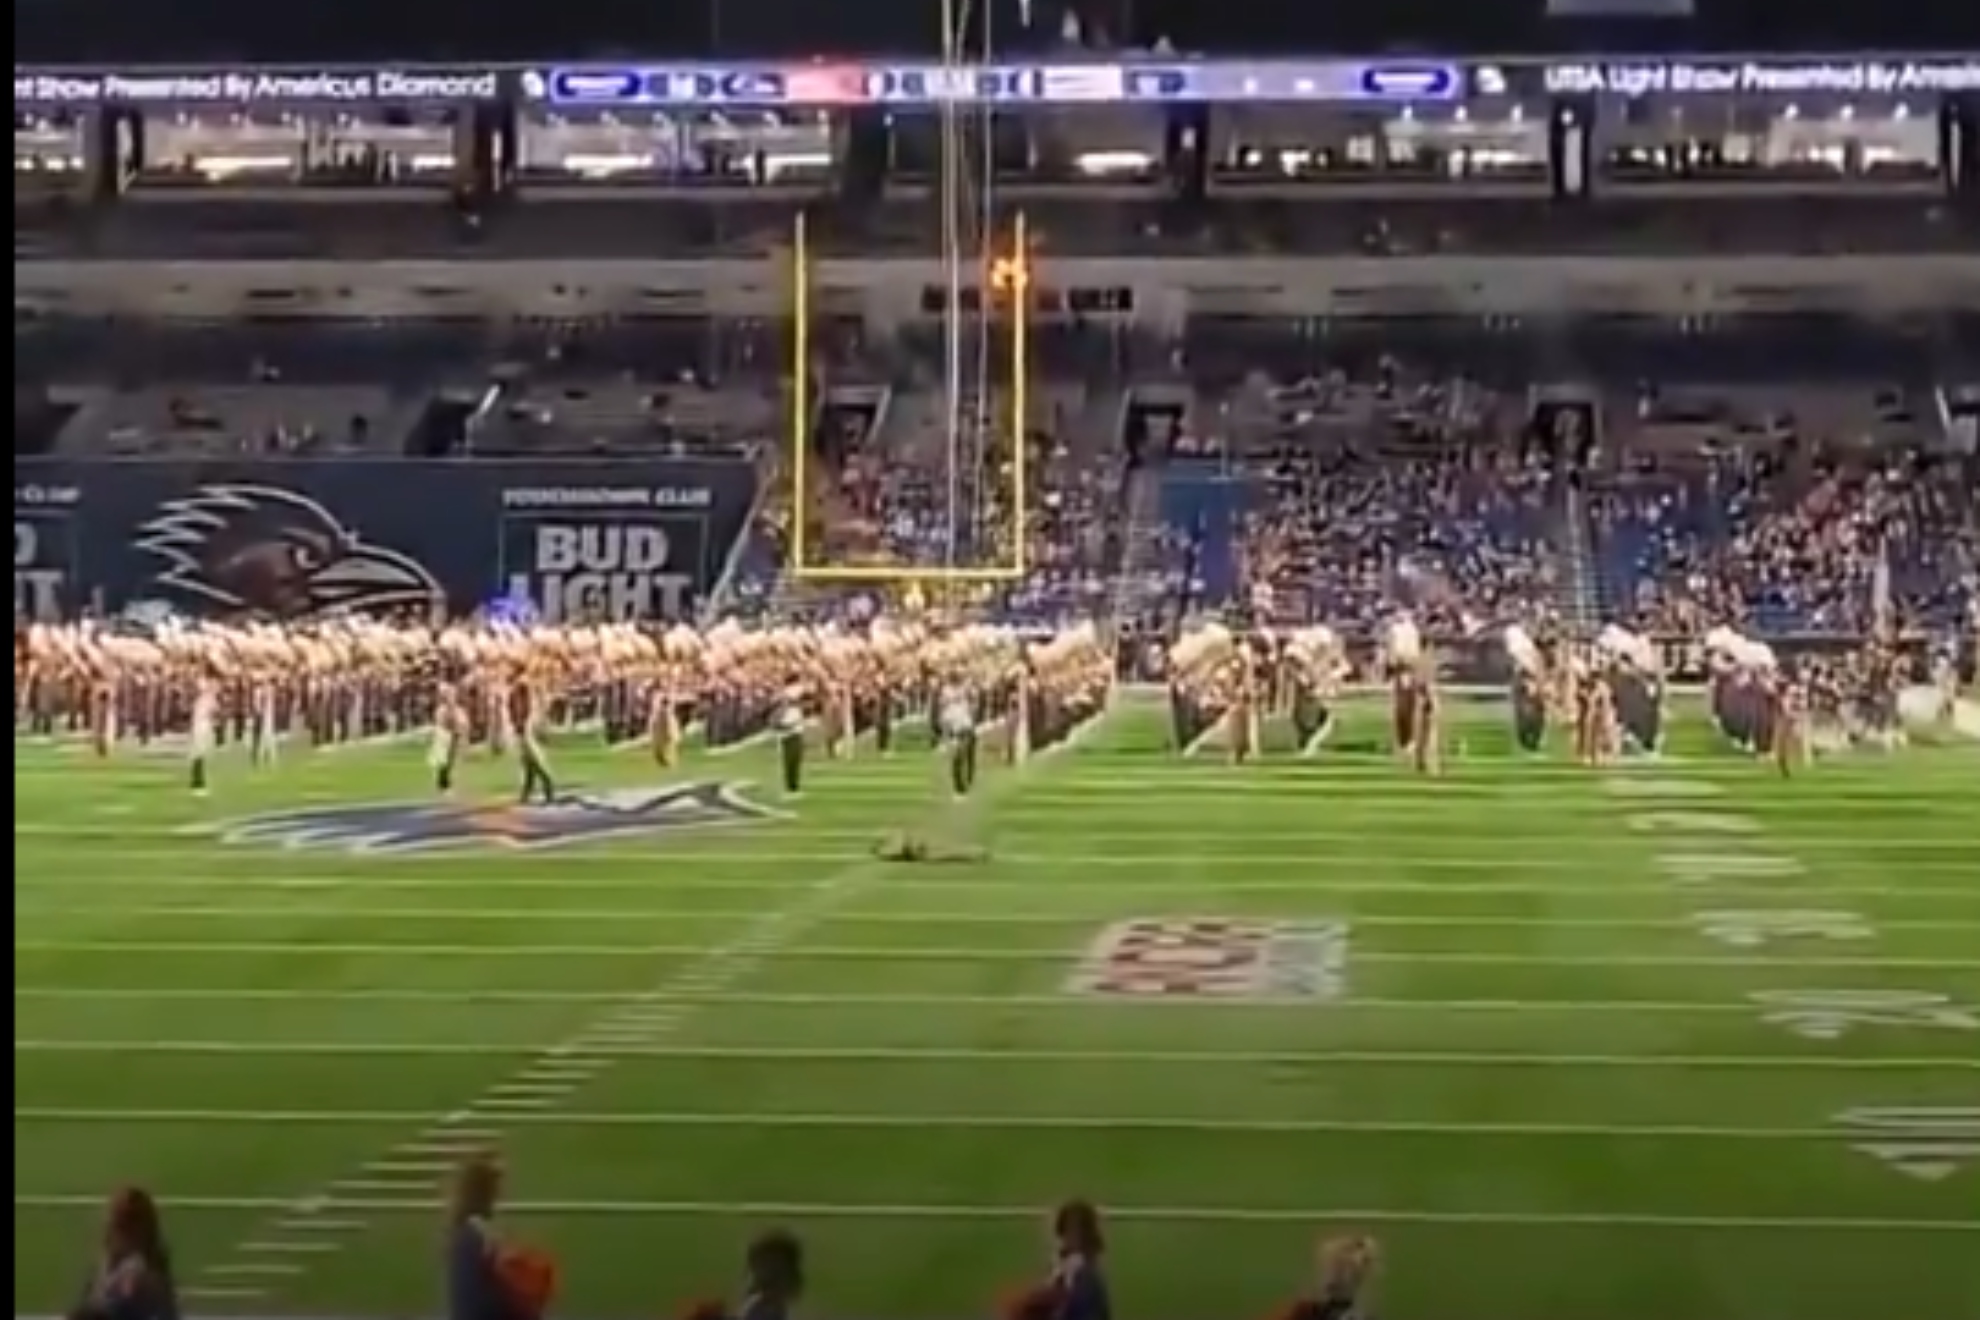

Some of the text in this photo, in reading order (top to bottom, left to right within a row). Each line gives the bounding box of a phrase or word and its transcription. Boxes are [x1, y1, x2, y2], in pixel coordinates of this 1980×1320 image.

[36, 76, 100, 99] Show
[104, 75, 220, 98] Presented
[225, 74, 252, 103] By
[376, 72, 496, 97] Diamond
[1741, 63, 1863, 92] Presented
[1868, 65, 1897, 93] By
[535, 525, 668, 571] BUD
